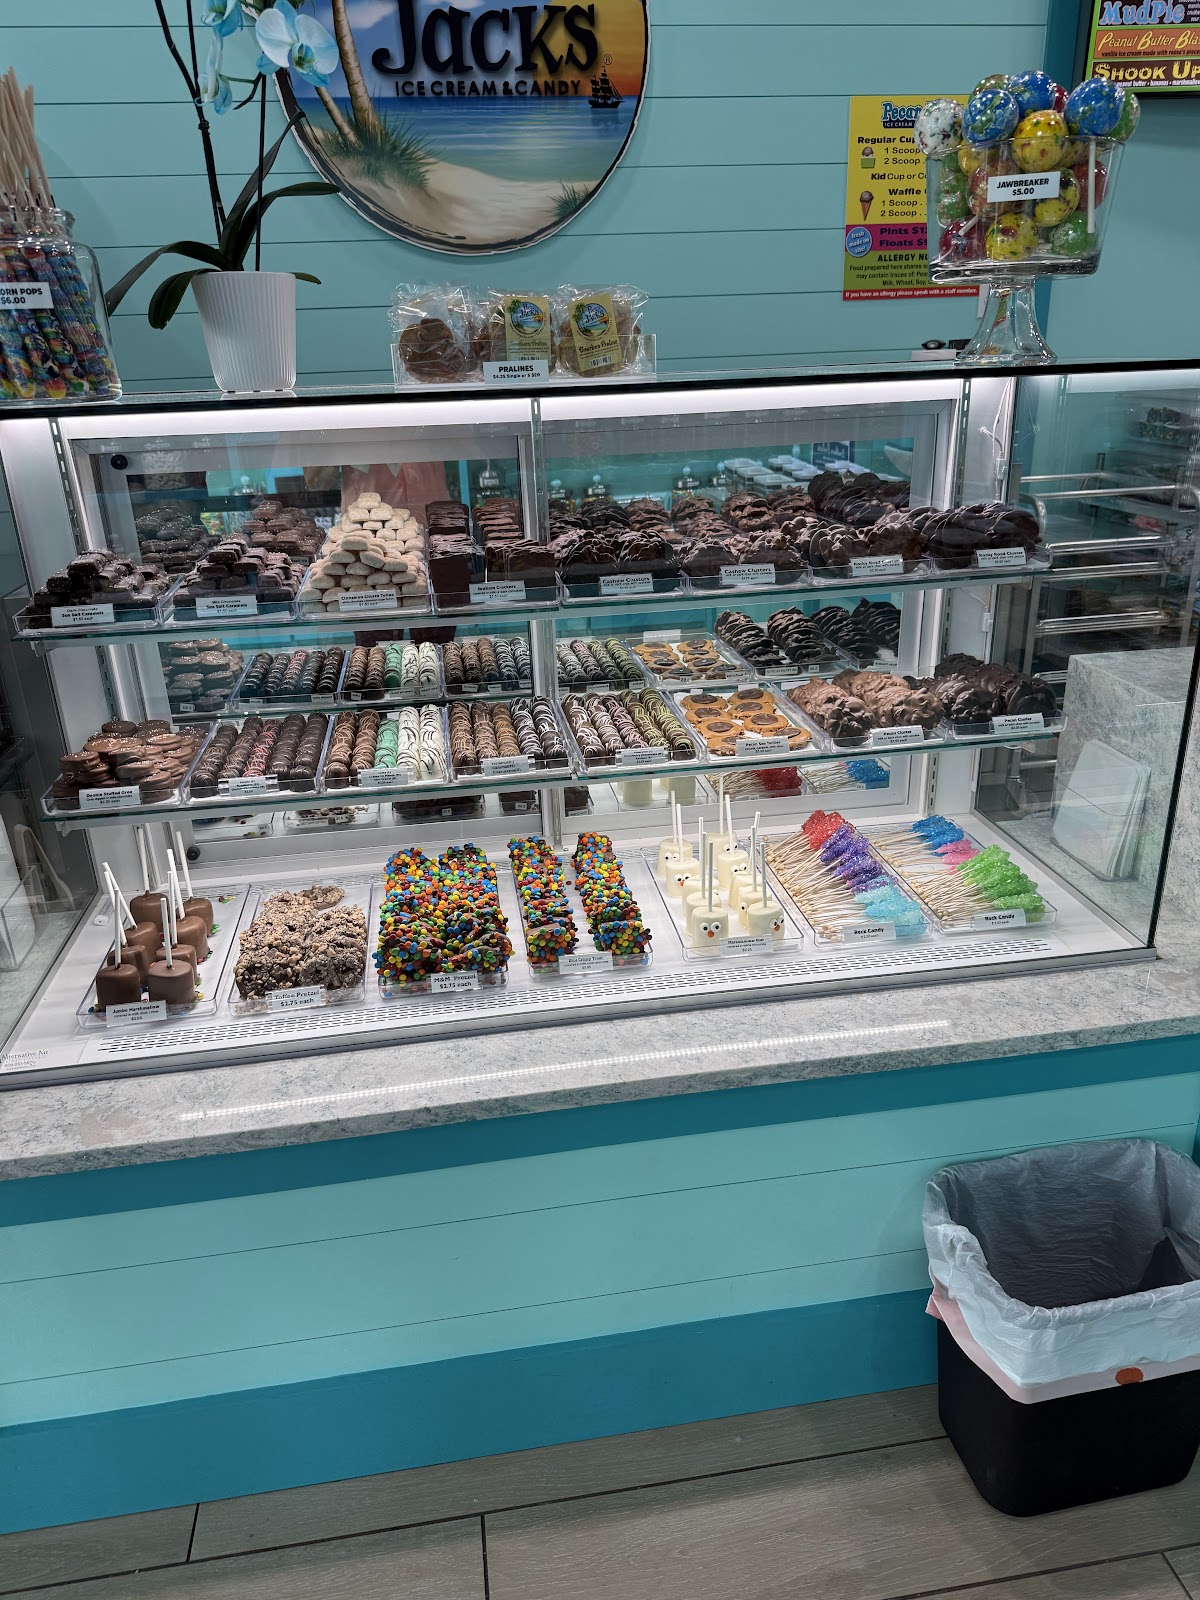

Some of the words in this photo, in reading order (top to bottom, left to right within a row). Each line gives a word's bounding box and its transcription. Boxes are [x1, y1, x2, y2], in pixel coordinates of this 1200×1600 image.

[1097, 32, 1138, 51] Peanut
[1137, 31, 1176, 50] Butter
[395, 80, 425, 96] ICE
[431, 80, 497, 96] CREAM
[514, 80, 581, 96] CANDY
[857, 136, 897, 144] Regular
[892, 147, 921, 155] Scoop
[892, 157, 921, 165] Scoop
[871, 173, 886, 181] Kid
[887, 173, 905, 181] Cup
[997, 178, 1049, 189] JAWBREAKER
[888, 188, 922, 196] Waffle
[1012, 187, 1035, 196] $5.00
[888, 199, 918, 207] Scoop
[888, 209, 917, 217] Scoop
[851, 231, 865, 239] fresh
[880, 227, 909, 235] Pints
[880, 239, 914, 247] Floats
[877, 253, 916, 262] ALLERGY
[19, 288, 43, 296] POPS
[1, 296, 26, 305] $6.00
[498, 365, 534, 373] PRALINES
[453, 973, 476, 981] Pretzel
[296, 989, 320, 997] Pretzel
[1, 1051, 37, 1060] Alternative
